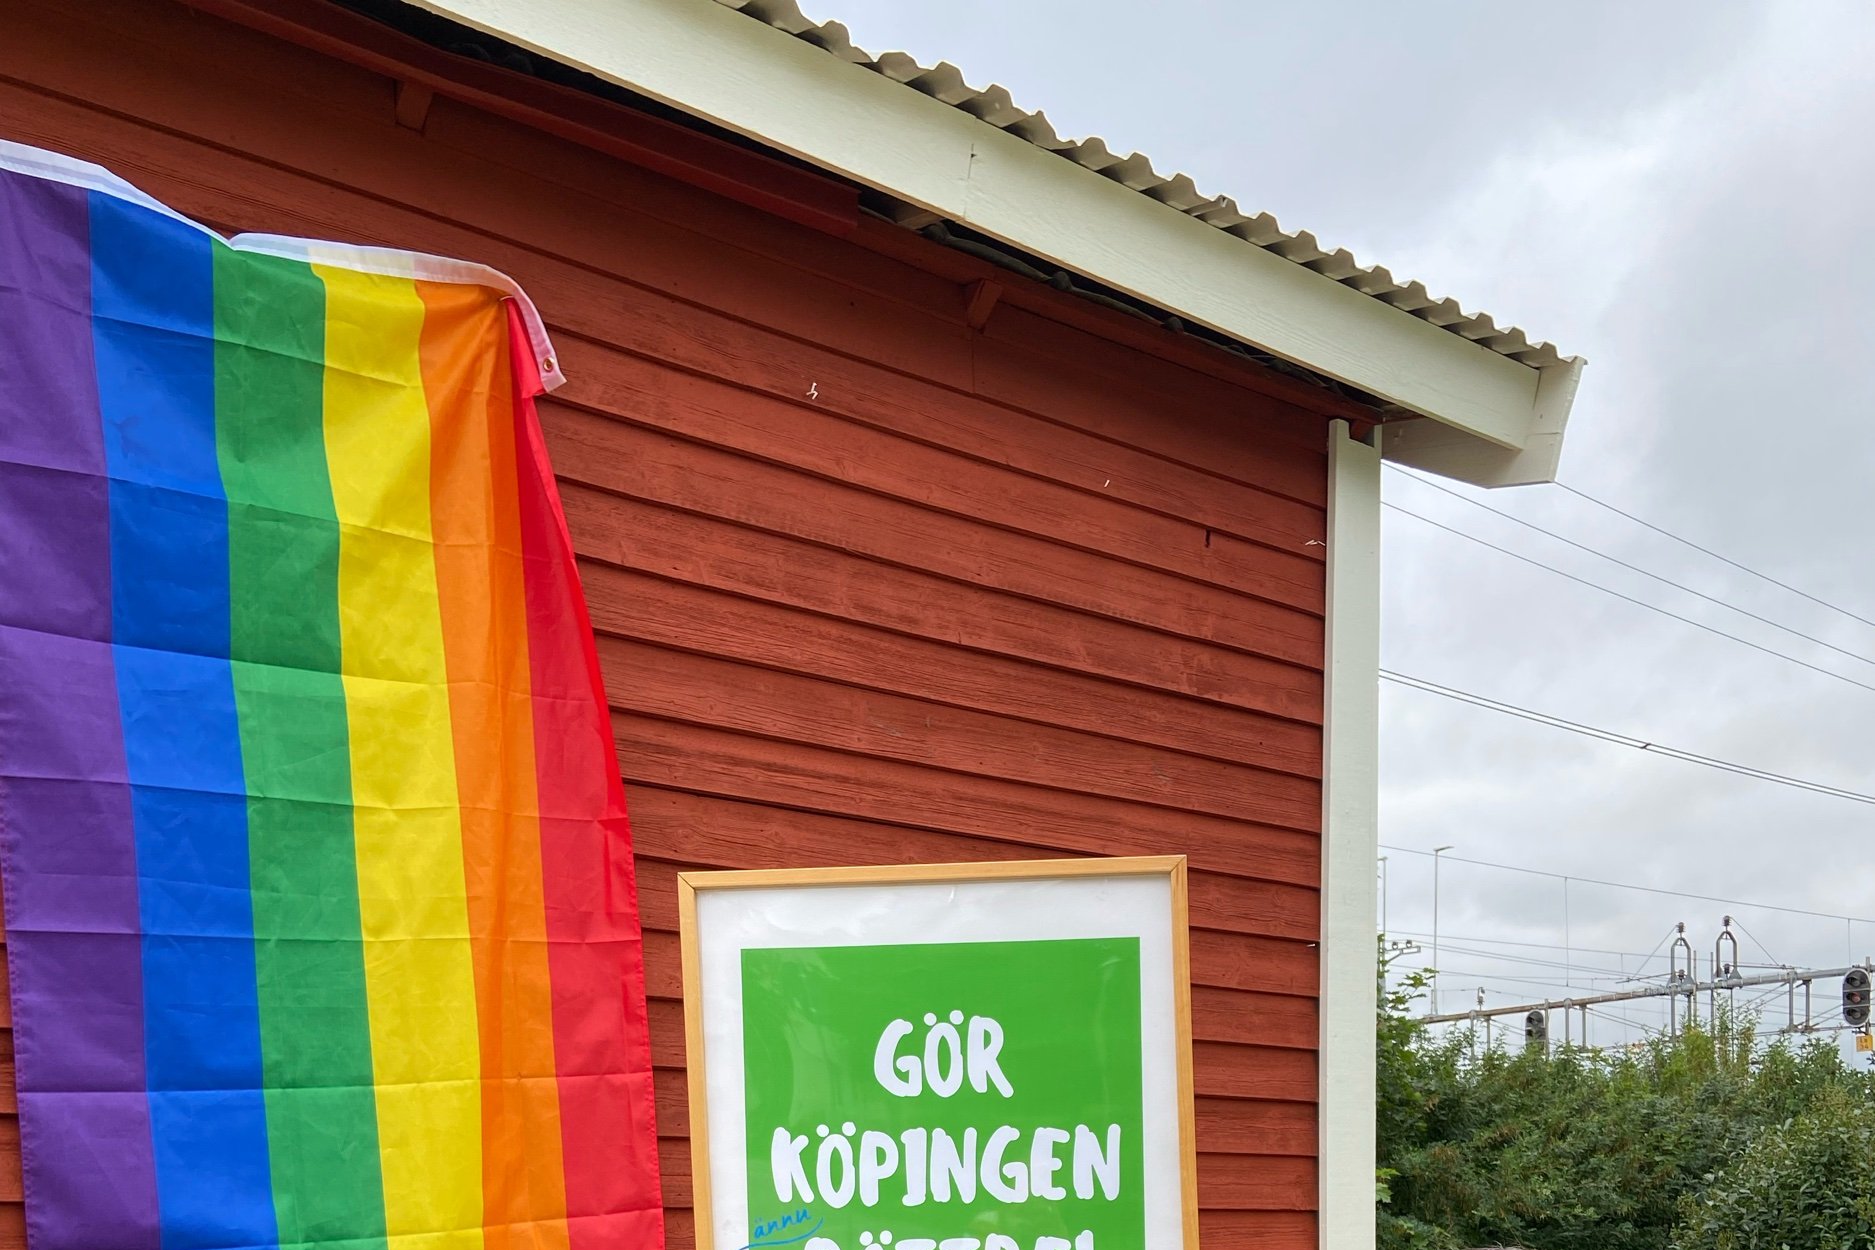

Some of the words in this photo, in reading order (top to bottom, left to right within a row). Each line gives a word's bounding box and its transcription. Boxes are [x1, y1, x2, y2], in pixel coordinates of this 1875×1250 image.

[874, 1010, 1014, 1098] GÖR
[771, 1121, 1121, 1208] KÖPINGEN
[754, 1208, 811, 1239] ännu
